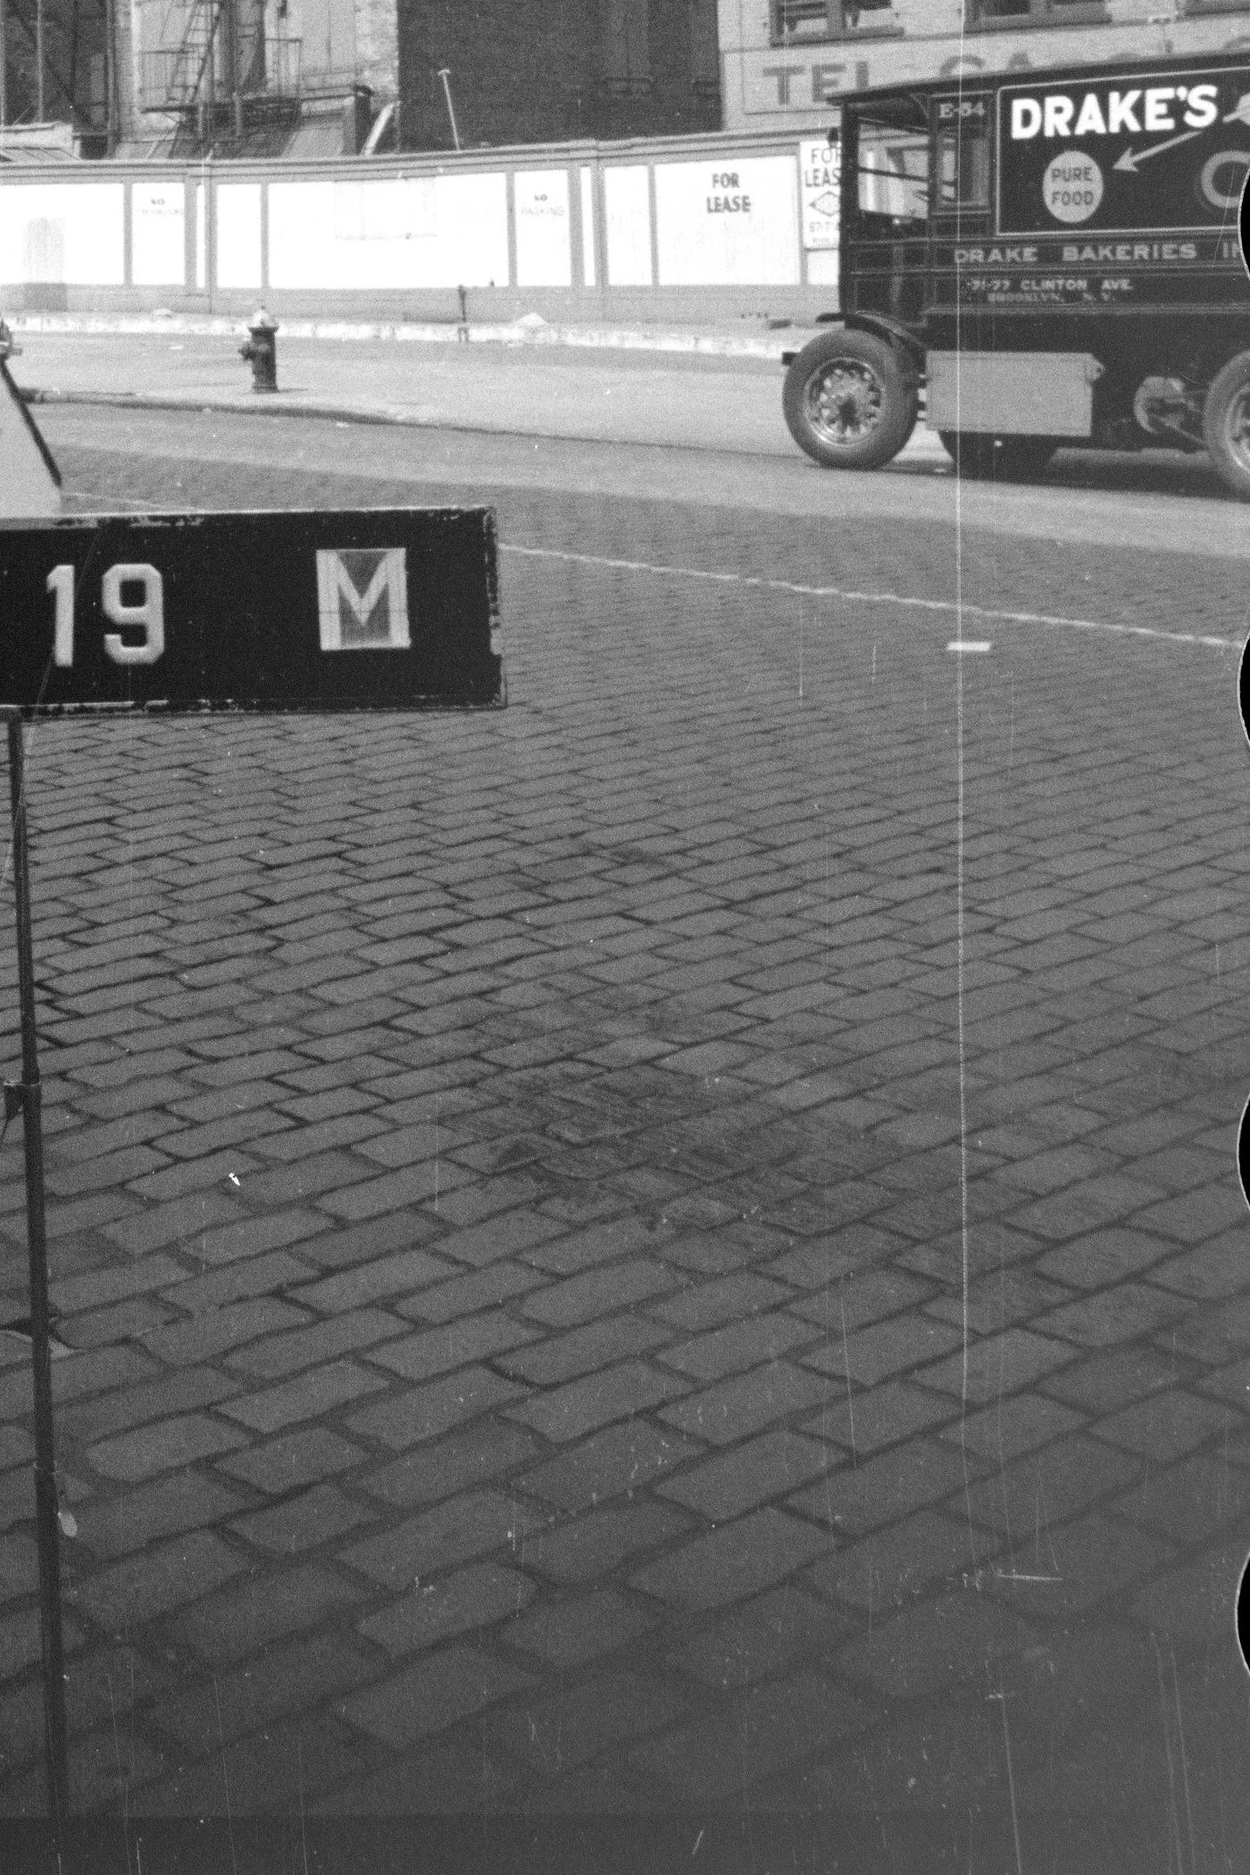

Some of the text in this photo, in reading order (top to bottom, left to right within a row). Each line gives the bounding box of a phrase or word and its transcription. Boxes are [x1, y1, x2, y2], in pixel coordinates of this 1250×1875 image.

[1011, 84, 1219, 140] DRAKE'S
[711, 173, 740, 189] FOR
[805, 168, 841, 187] LEAS
[1051, 166, 1093, 182] PURE
[533, 193, 548, 202] NO
[705, 195, 751, 213] LEASE
[1051, 189, 1094, 207] FOOD
[954, 246, 1038, 263] DRAKE
[1062, 243, 1197, 262] BAKERIES
[1021, 279, 1088, 291] CLINTON
[46, 562, 165, 666] 19
[316, 547, 410, 650] M
